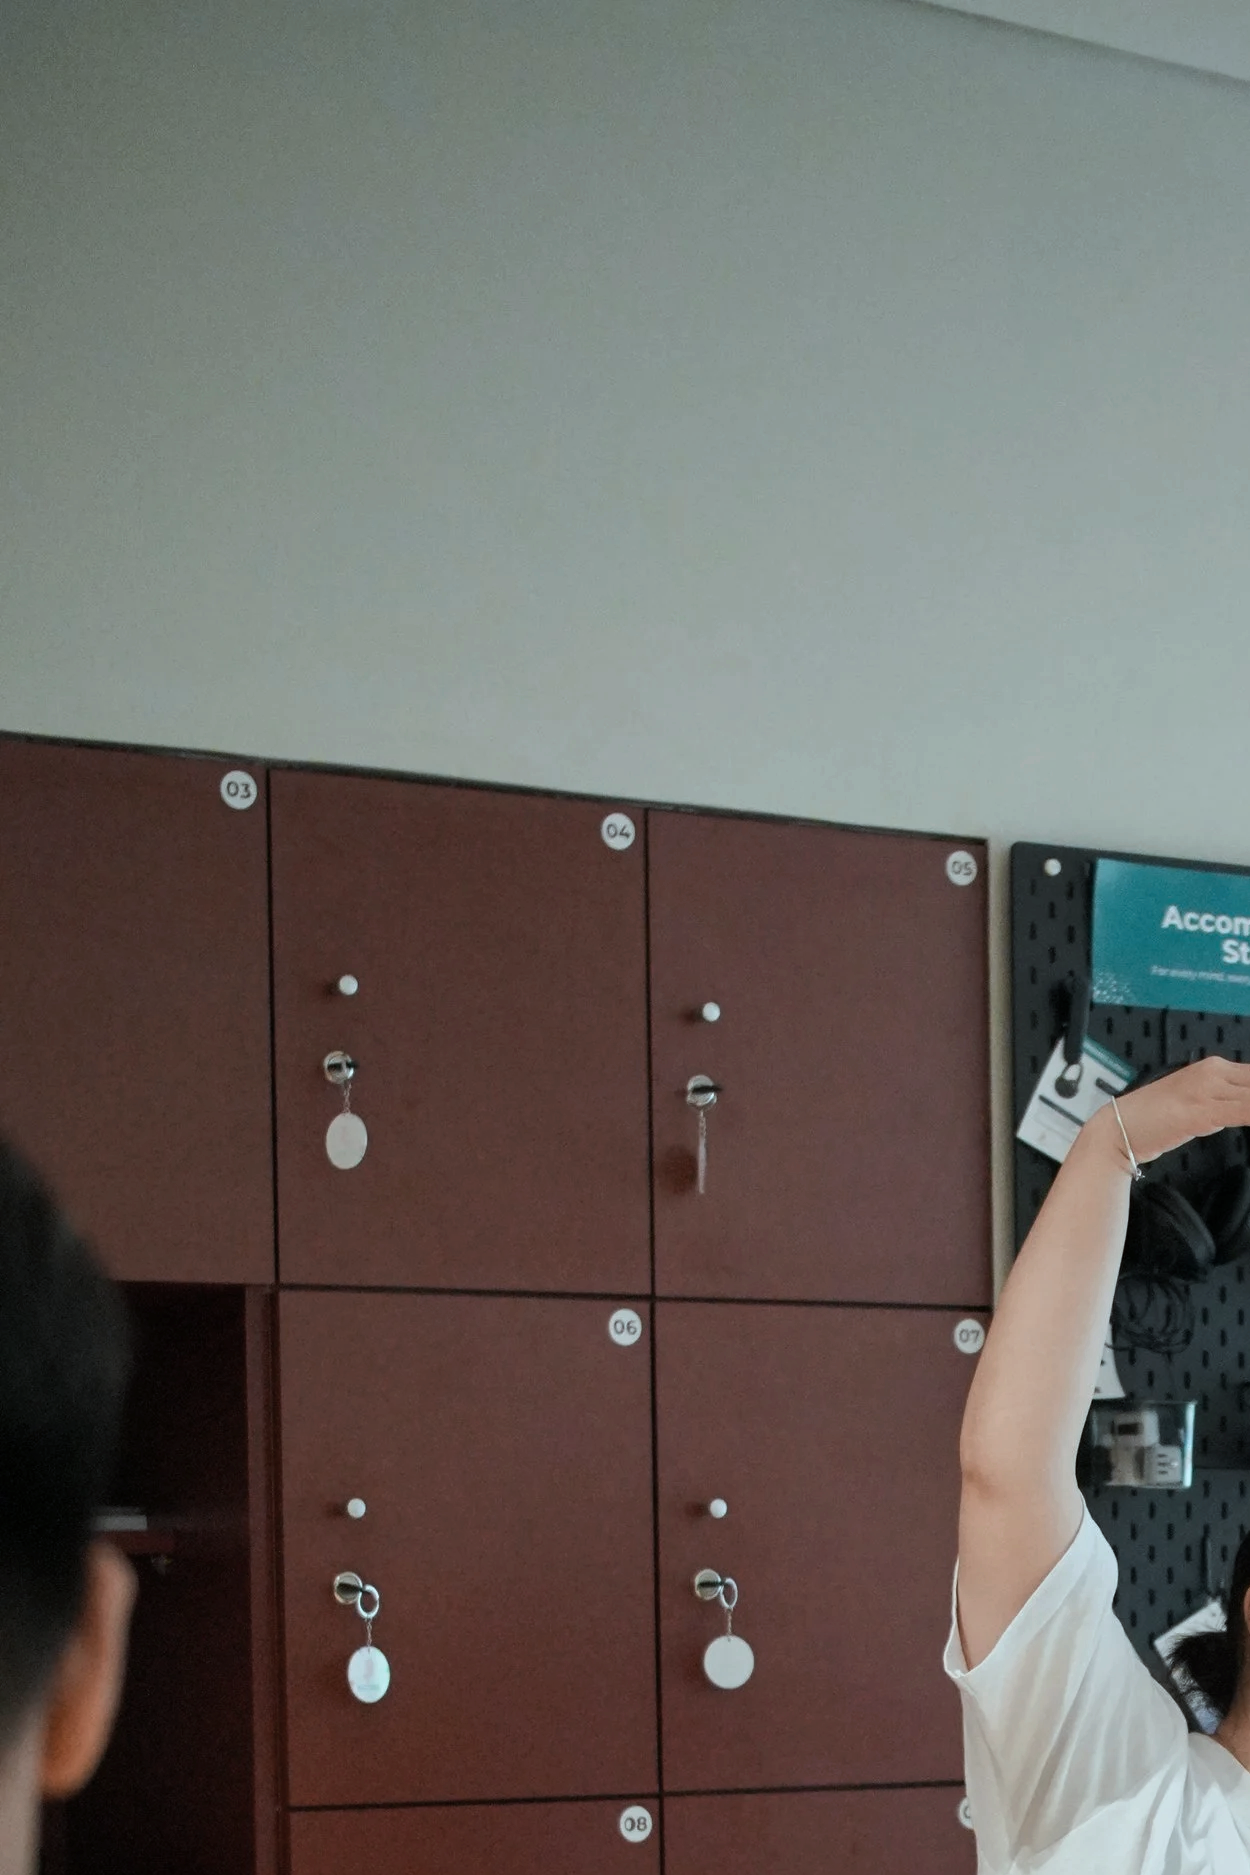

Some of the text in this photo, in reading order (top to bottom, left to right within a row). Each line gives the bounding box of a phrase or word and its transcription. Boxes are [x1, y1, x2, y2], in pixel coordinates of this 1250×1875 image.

[226, 781, 251, 799] 03
[606, 823, 632, 839] 04
[951, 860, 973, 876] 05
[613, 1319, 638, 1336] 06
[958, 1329, 981, 1344] 07
[624, 1816, 648, 1832] 08
